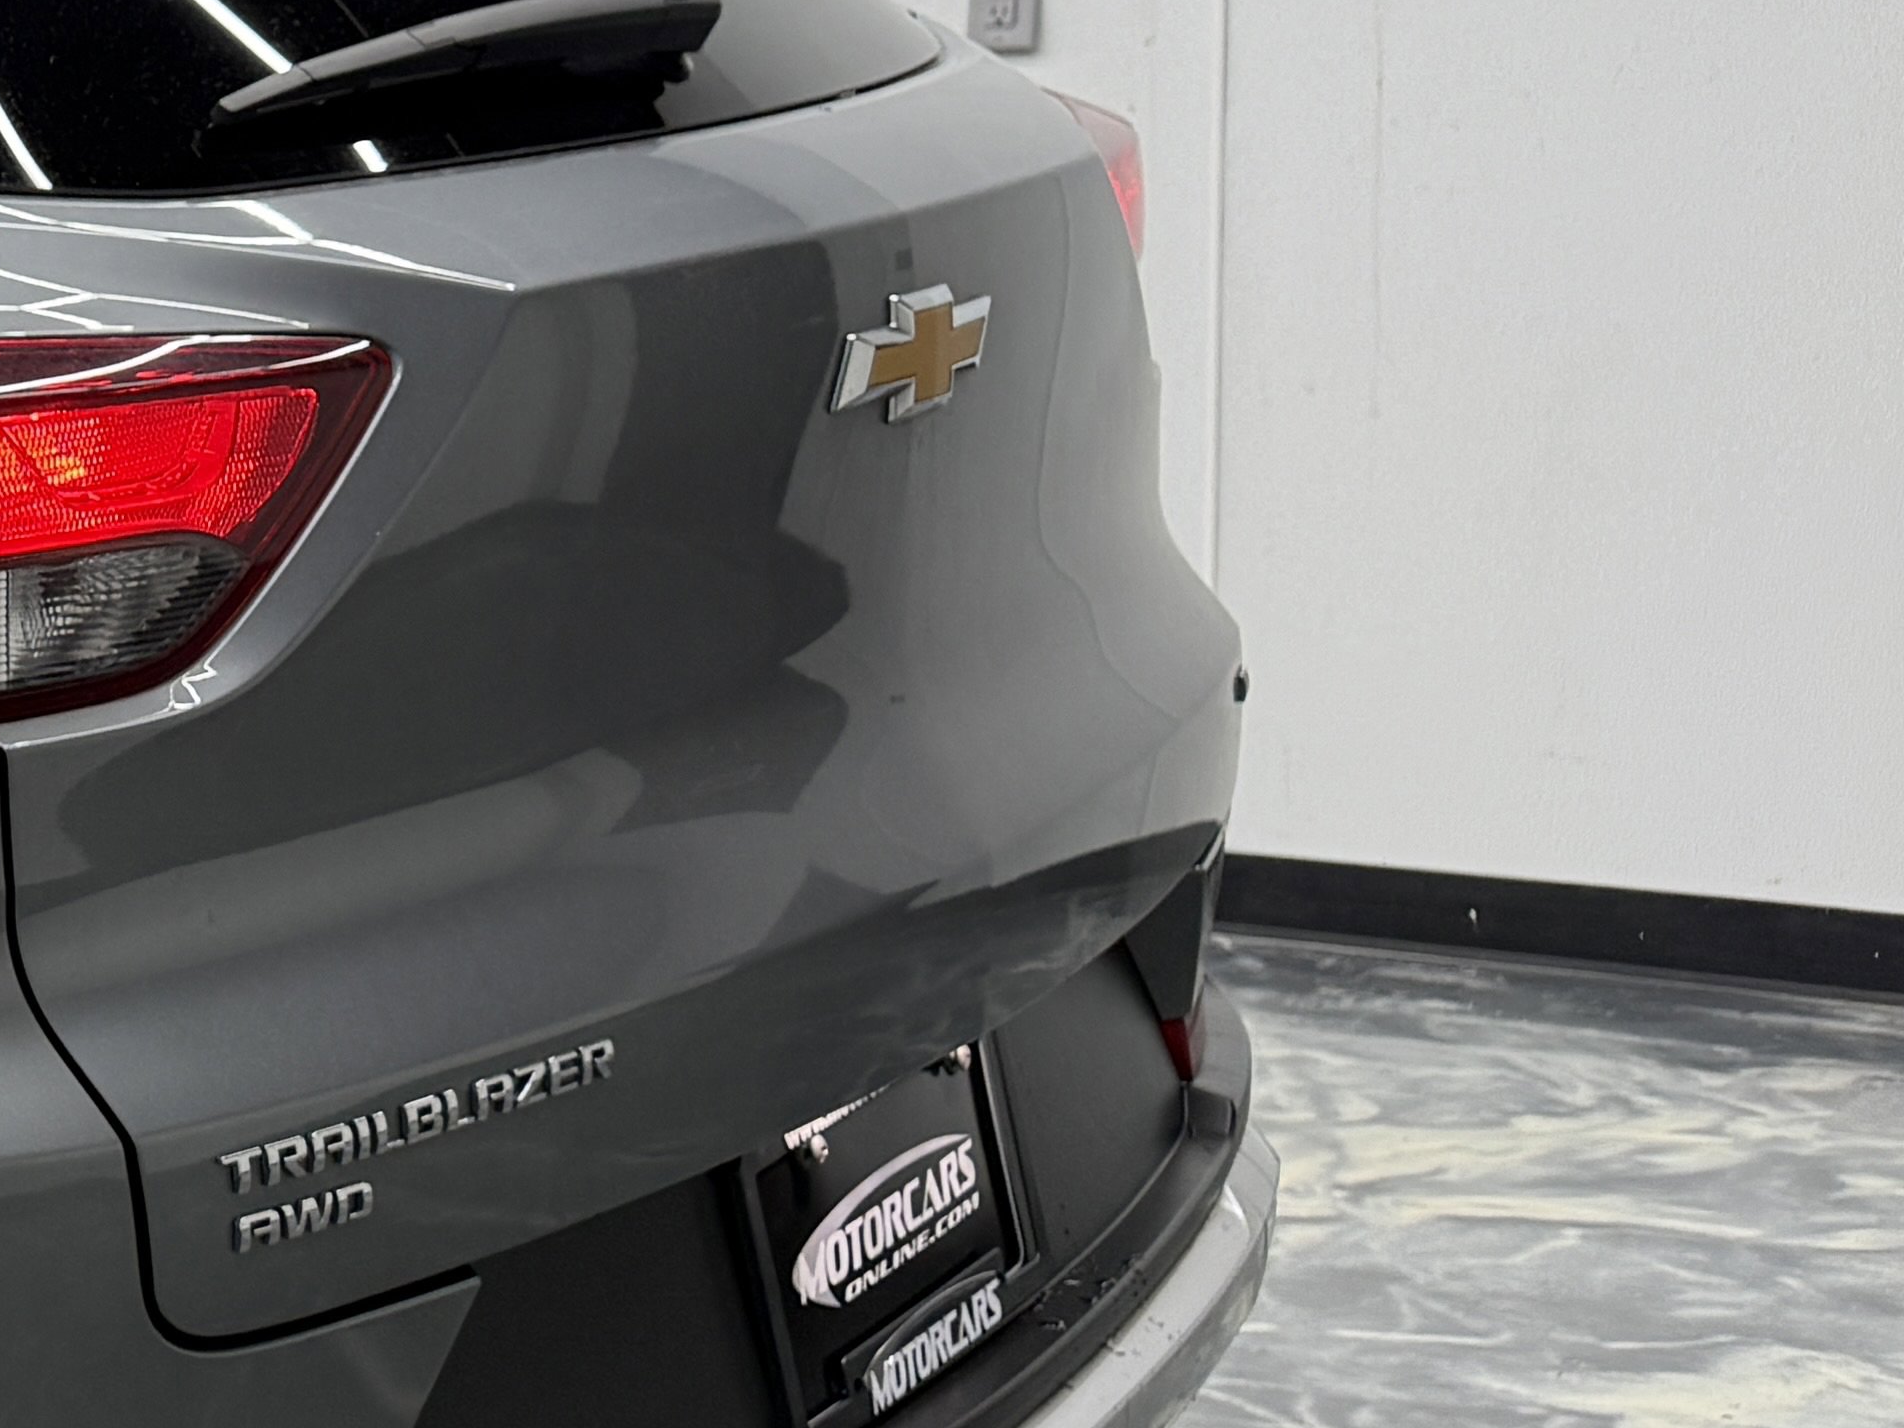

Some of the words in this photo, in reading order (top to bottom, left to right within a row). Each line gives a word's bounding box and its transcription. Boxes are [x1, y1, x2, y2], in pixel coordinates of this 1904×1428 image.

[218, 1038, 615, 1194] TRAILBLAZER
[233, 1181, 374, 1254] AWD
[796, 1137, 977, 1306] MOTORCARS
[844, 1190, 980, 1303] ONLINE.COM
[869, 1278, 1003, 1417] MOTORCARS
